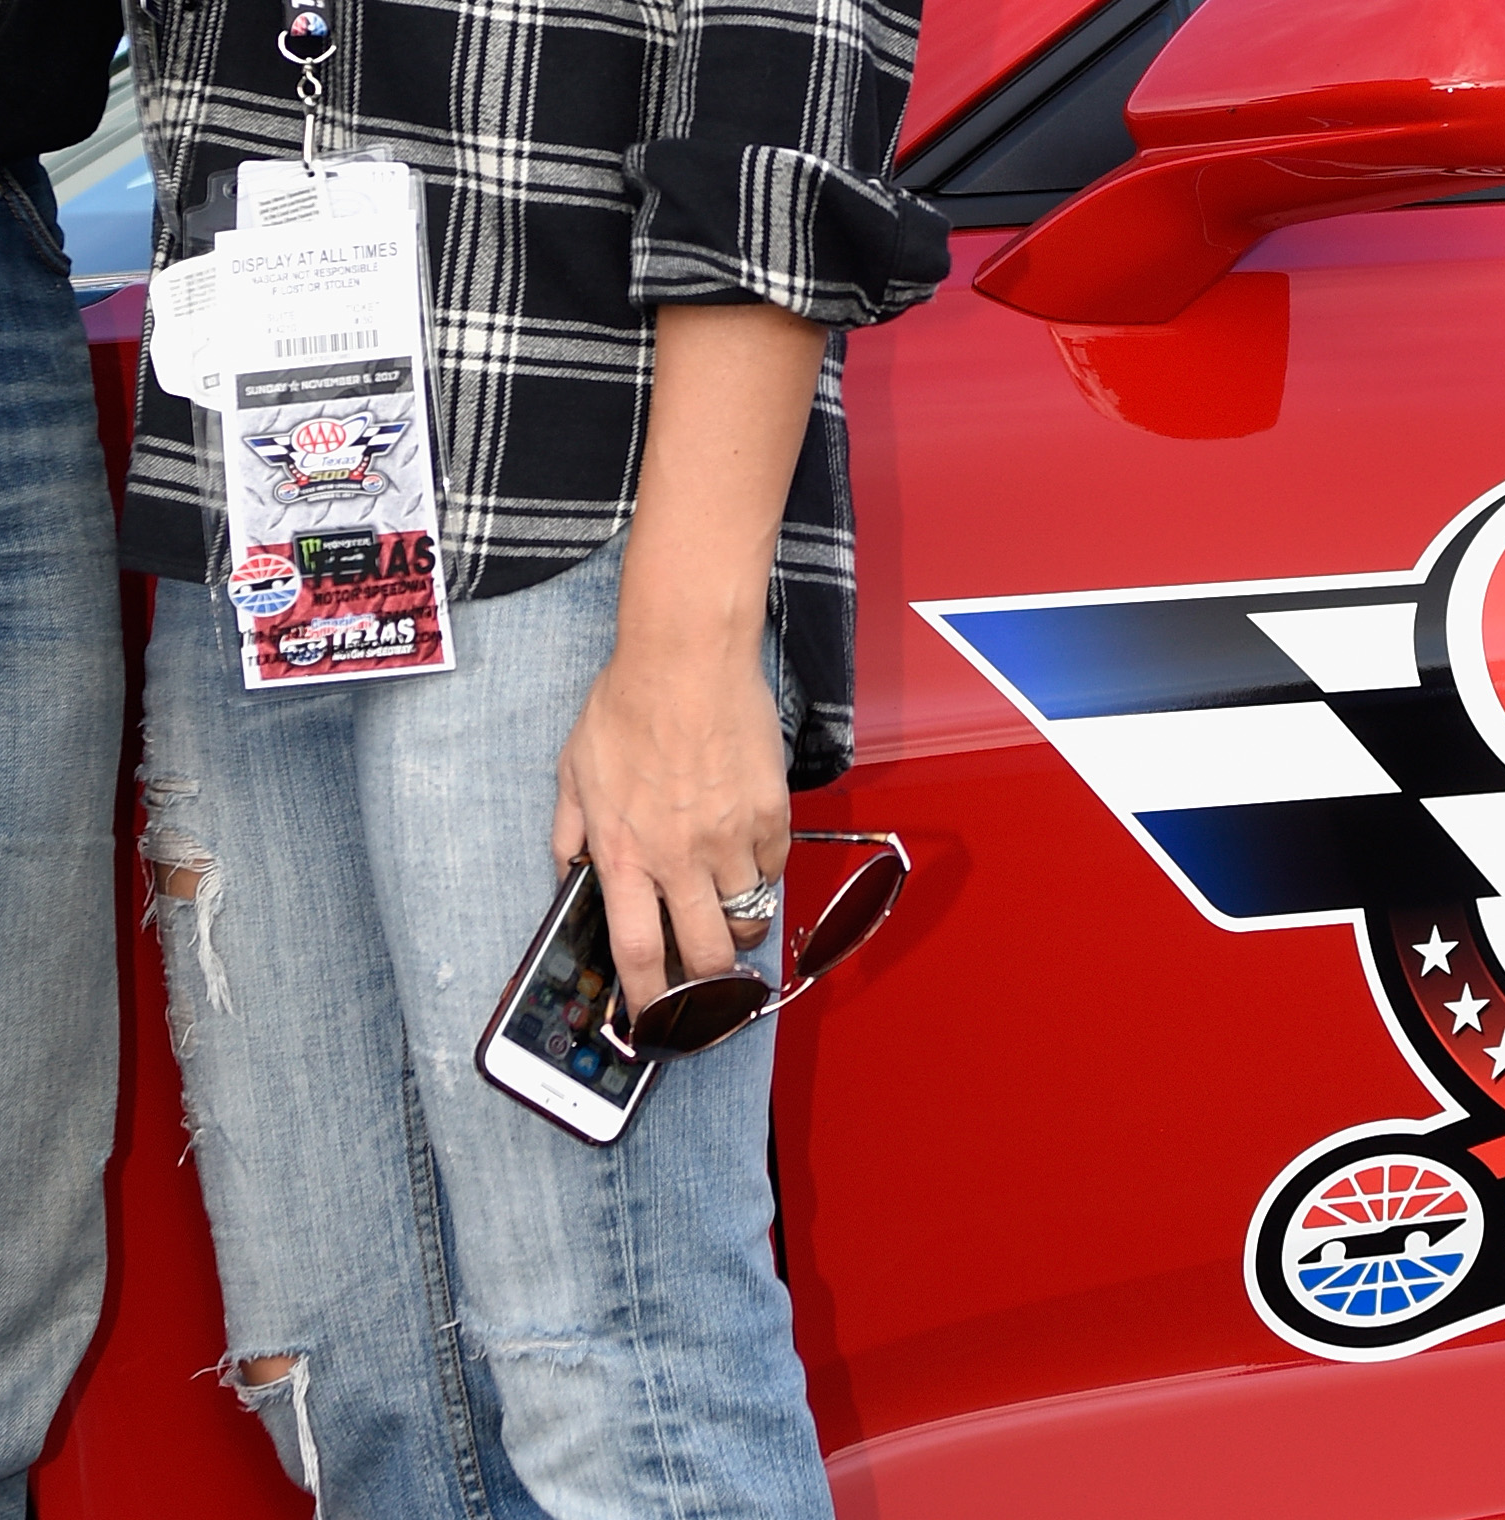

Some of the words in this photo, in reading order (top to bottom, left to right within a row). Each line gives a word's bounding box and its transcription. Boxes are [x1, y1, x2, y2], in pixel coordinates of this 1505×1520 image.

[232, 253, 293, 275] DISPLAY
[297, 250, 315, 266] AT
[319, 248, 348, 264] ALL
[352, 241, 398, 260] TIMES
[313, 262, 378, 278] RESPONSIBLE
[307, 281, 321, 293] OR
[325, 278, 361, 291] STOLEN
[245, 383, 288, 397] SUNDAY
[300, 374, 361, 390] NOVEMBER
[298, 422, 344, 454] AAA
[320, 456, 357, 466] Texas
[308, 469, 351, 481] 500
[309, 536, 436, 588] TEXAS
[313, 587, 362, 605] MOTOR
